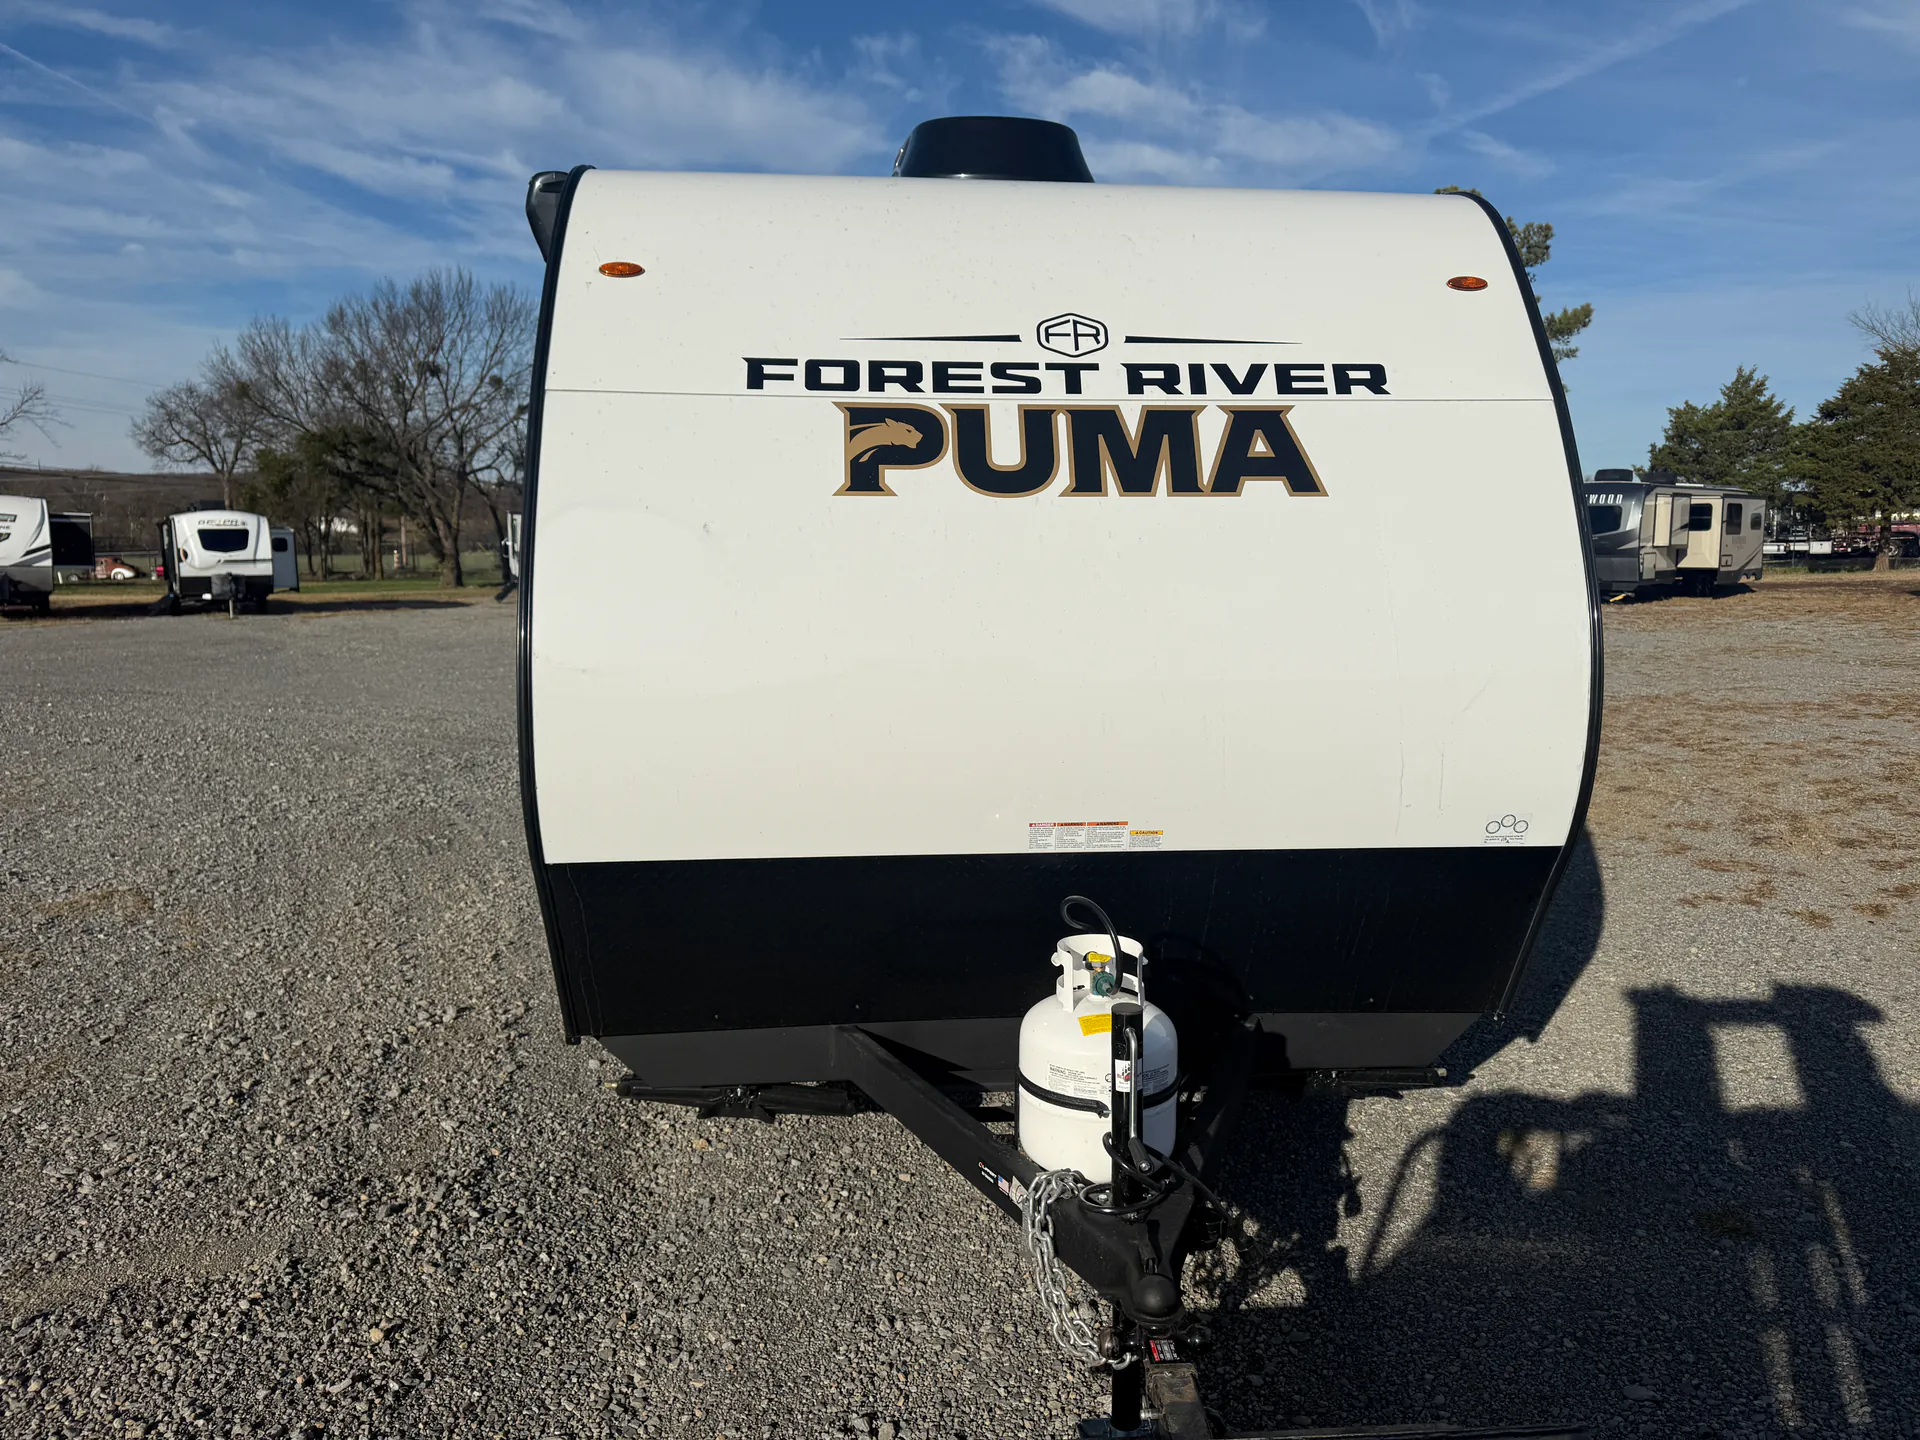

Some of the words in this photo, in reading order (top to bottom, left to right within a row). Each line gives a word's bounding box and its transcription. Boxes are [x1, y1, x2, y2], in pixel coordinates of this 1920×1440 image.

[1044, 318, 1101, 352] FR
[742, 357, 1100, 395] FOREST
[1121, 362, 1391, 395] RIVER
[832, 401, 1329, 498] PUMA
[1585, 493, 1623, 504] WOOD
